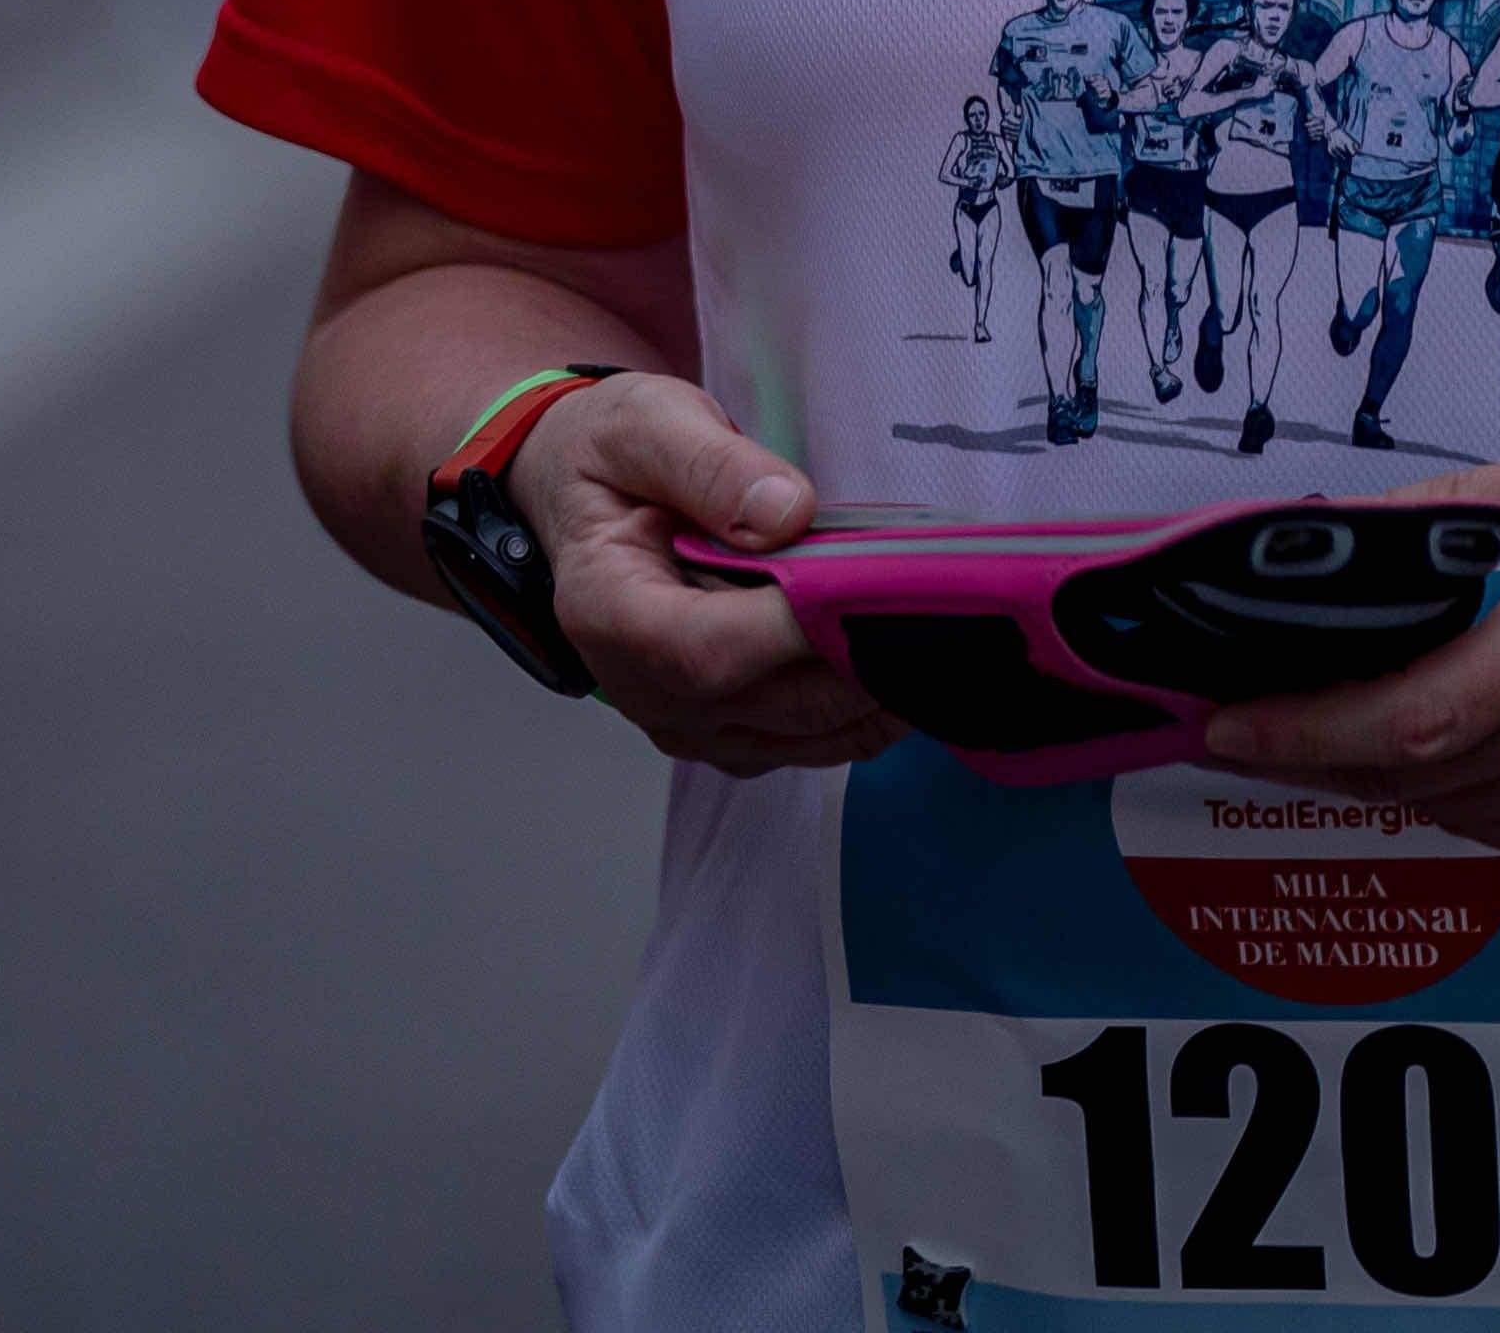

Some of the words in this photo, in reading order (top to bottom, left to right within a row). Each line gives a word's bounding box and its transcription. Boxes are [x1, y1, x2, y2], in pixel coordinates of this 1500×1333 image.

[1273, 872, 1389, 899] MILLA
[1236, 940, 1288, 967] DE
[1296, 941, 1440, 969] MADRID
